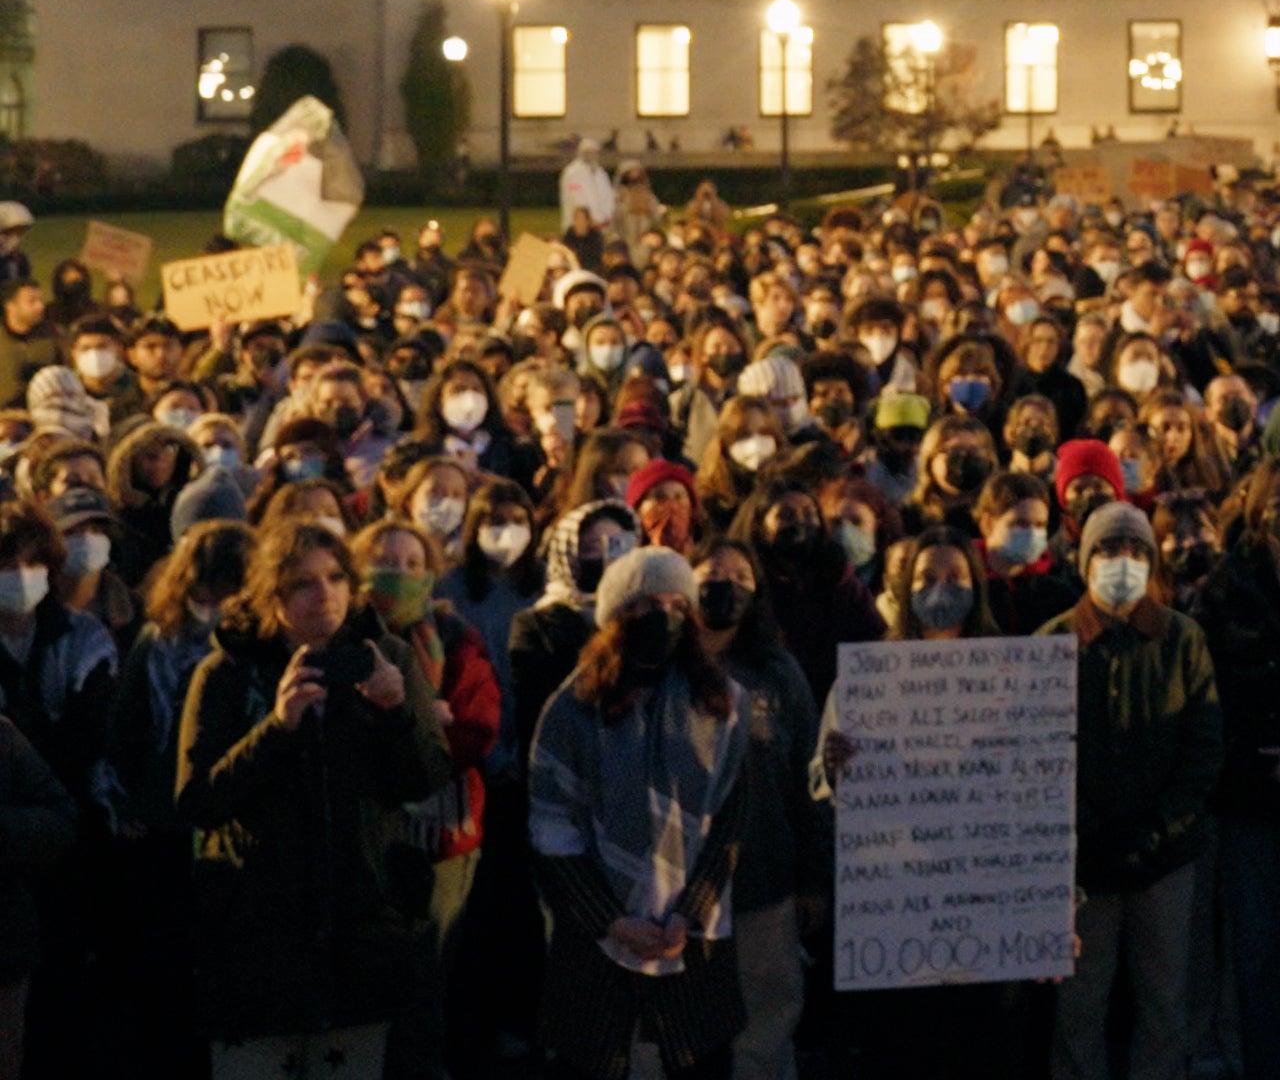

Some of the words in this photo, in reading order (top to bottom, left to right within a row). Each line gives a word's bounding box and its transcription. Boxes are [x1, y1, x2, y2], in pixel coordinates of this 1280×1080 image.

[204, 281, 265, 317] NOW
[930, 915, 974, 933] AND
[998, 930, 1073, 969] MORE
